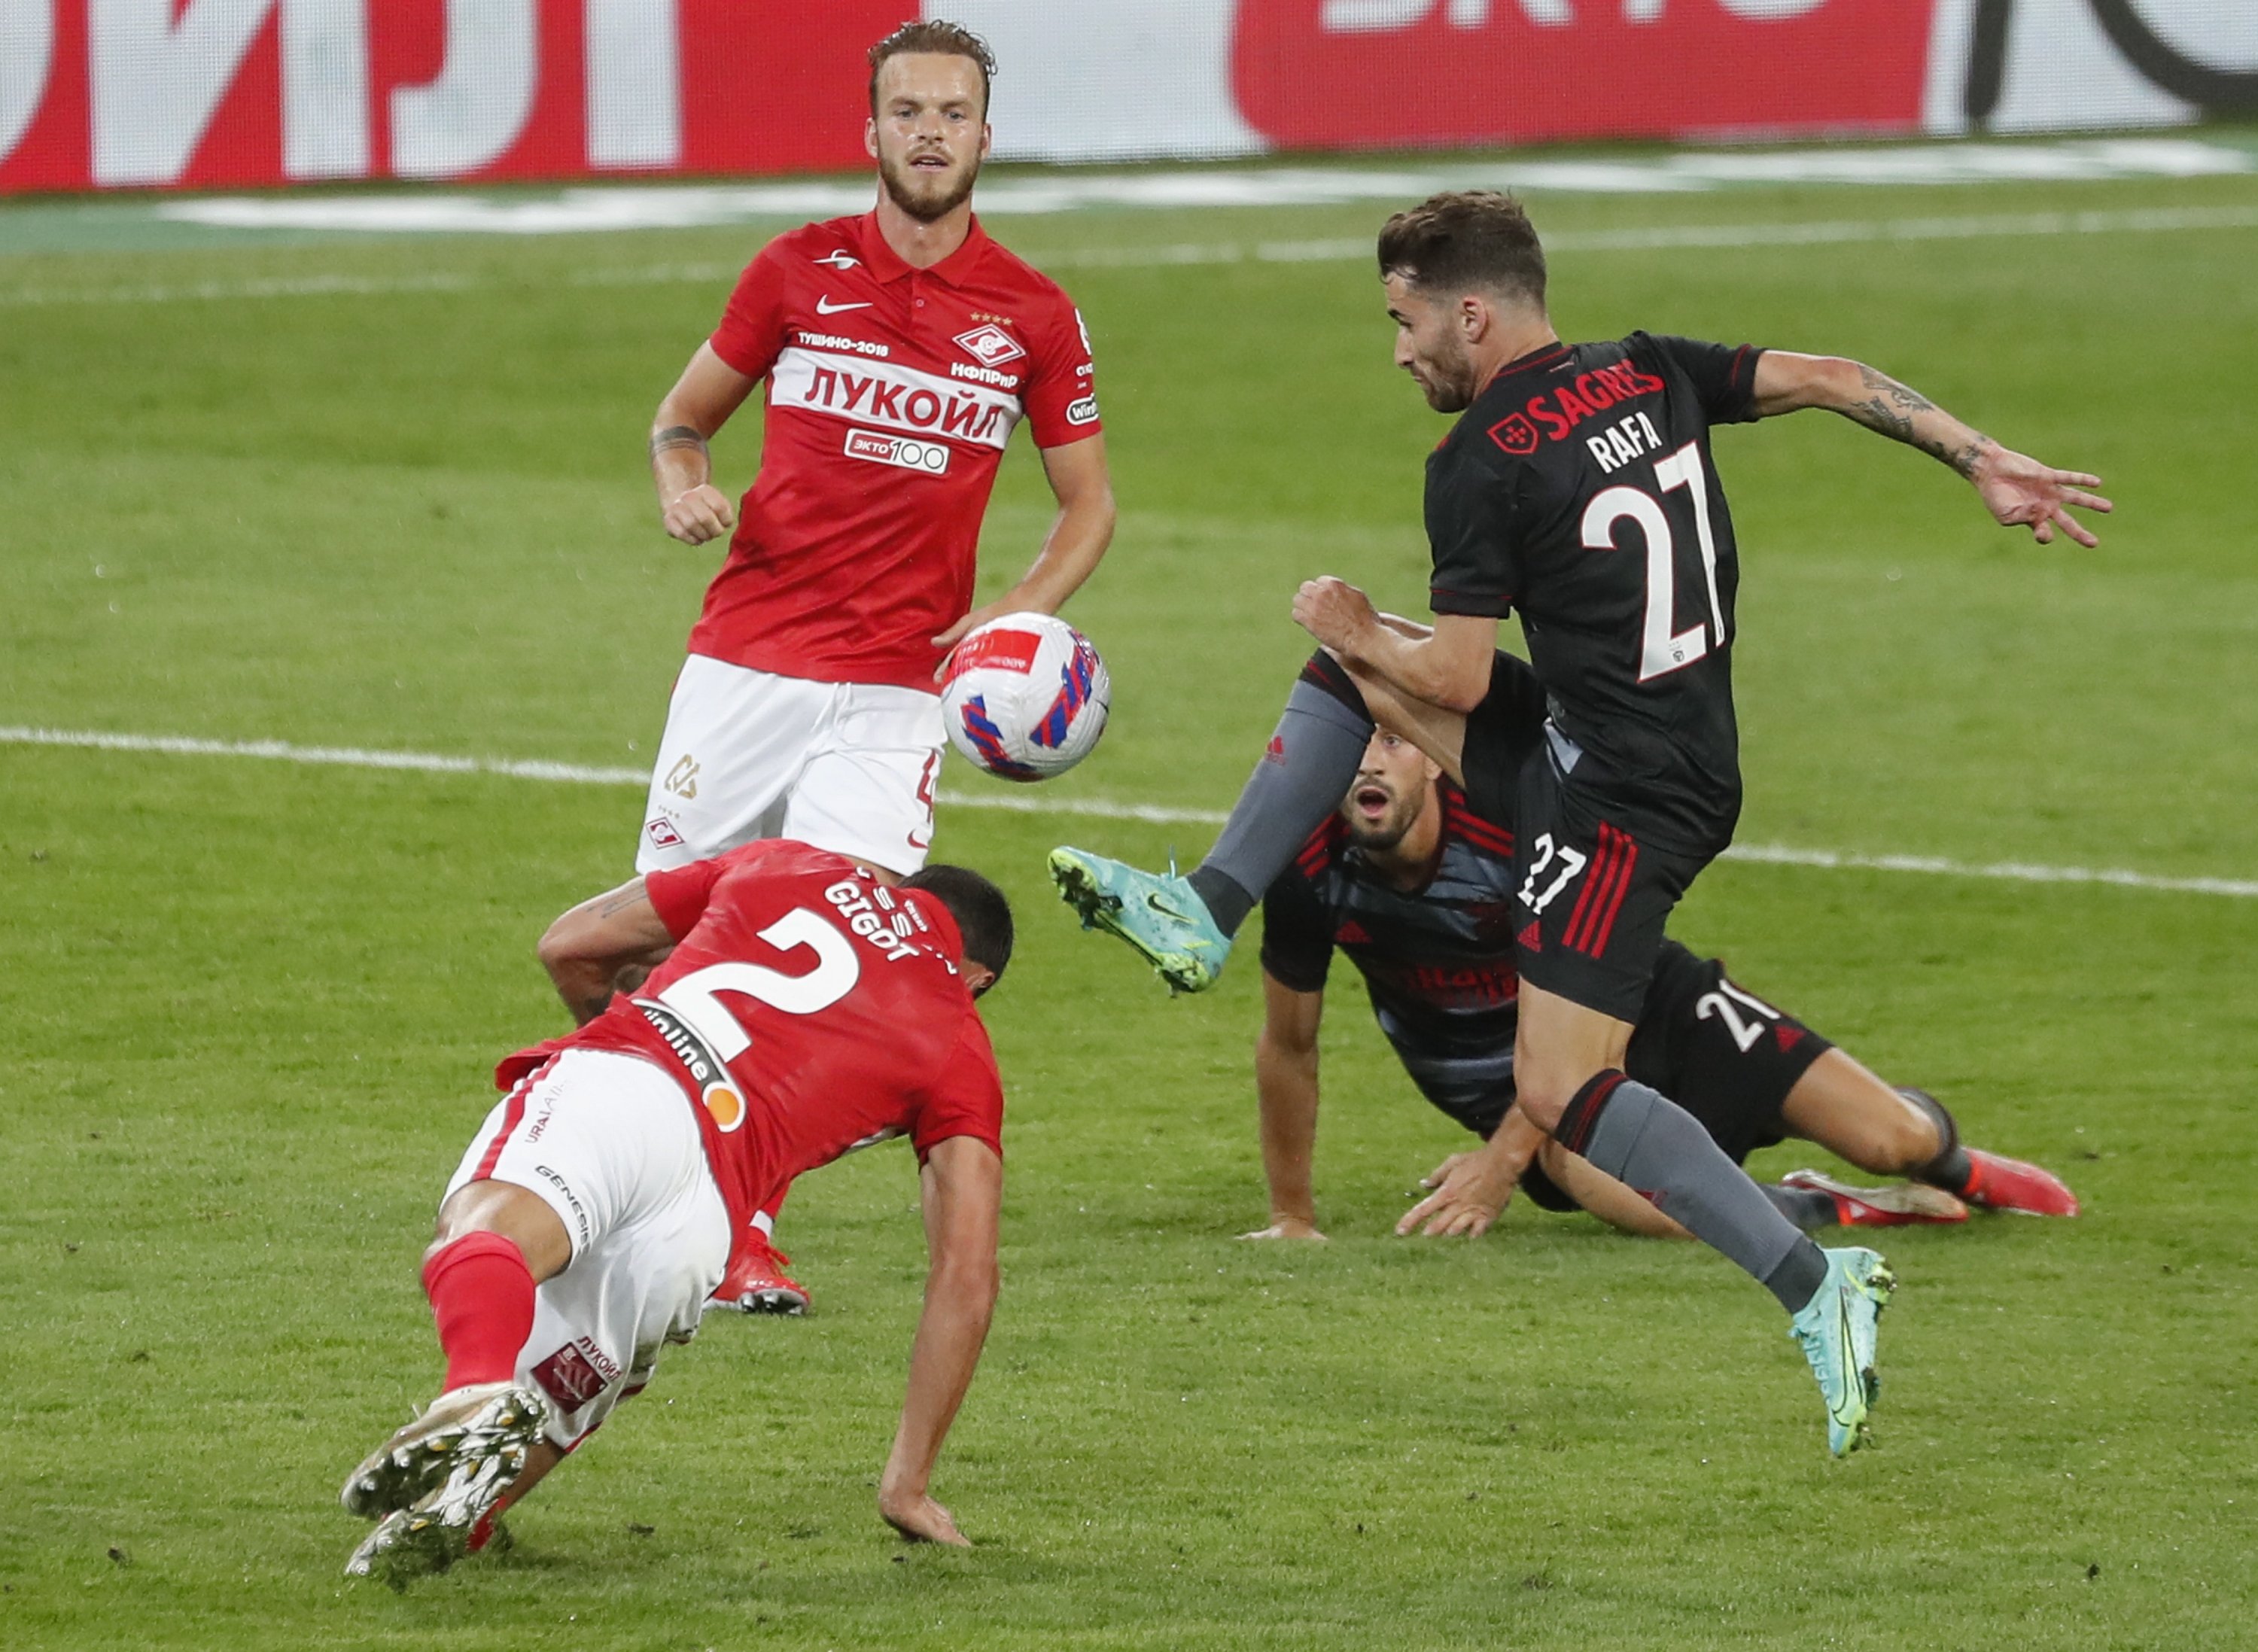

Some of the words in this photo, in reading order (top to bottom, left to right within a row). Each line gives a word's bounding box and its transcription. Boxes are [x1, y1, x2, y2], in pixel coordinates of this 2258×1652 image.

[798, 331, 889, 357] ТУШИНО-2018
[805, 367, 1003, 439] ЛУКОЙЛ
[1526, 358, 1666, 442] SAGRES
[1586, 411, 1663, 473] RAFA
[1581, 439, 1726, 683] 27
[1517, 832, 1587, 915] 27
[824, 880, 920, 962] GIGOT
[656, 907, 860, 1063] 2
[576, 1335, 623, 1382] ЛУКОЙЛ
